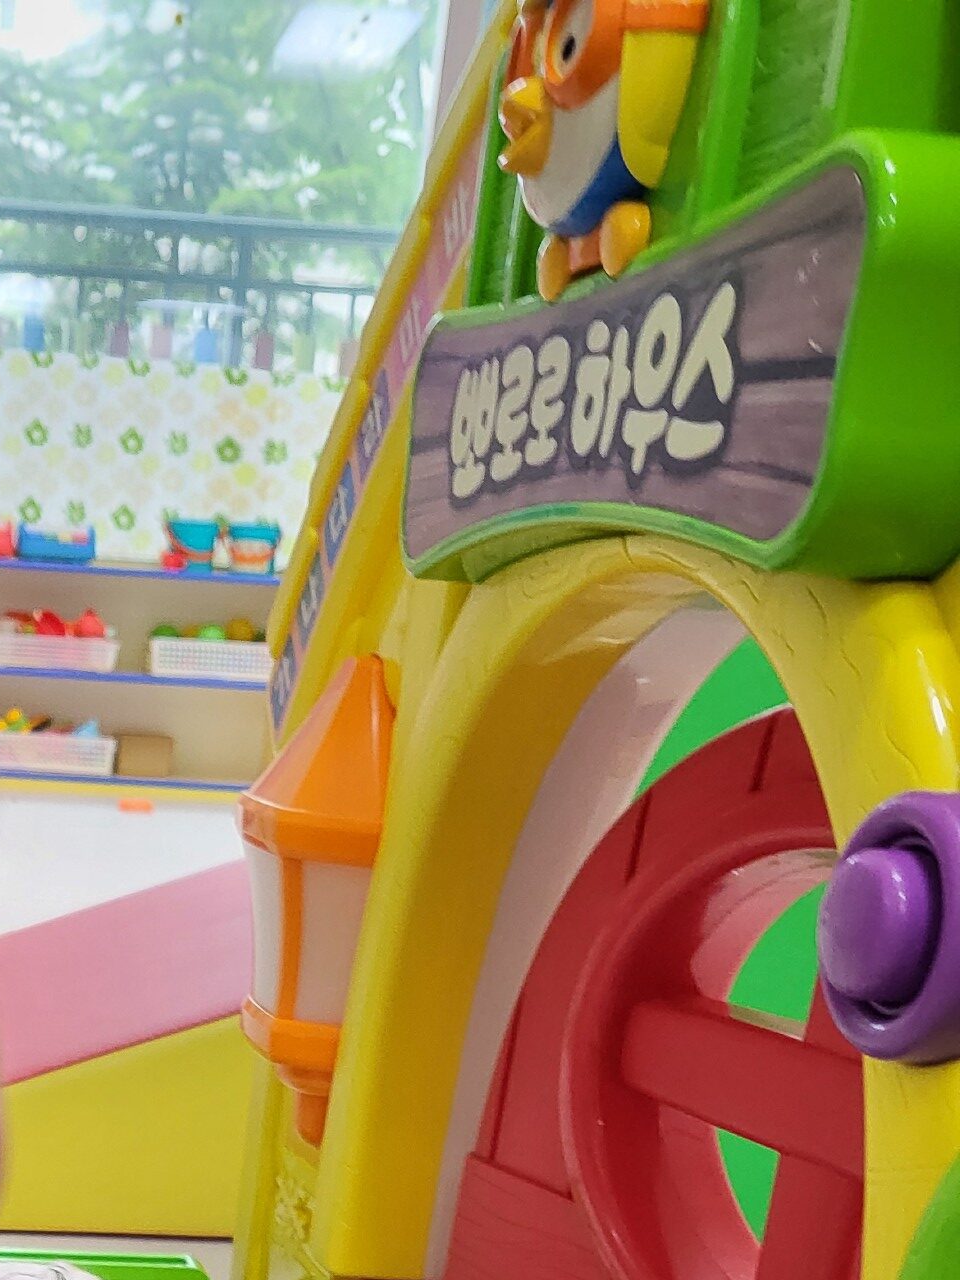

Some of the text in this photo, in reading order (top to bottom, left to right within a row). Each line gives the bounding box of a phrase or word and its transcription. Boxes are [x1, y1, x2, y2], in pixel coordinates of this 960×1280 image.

[443, 181, 470, 258] 바
[399, 295, 424, 364] 마
[362, 393, 384, 458] 라
[328, 483, 349, 542] 다
